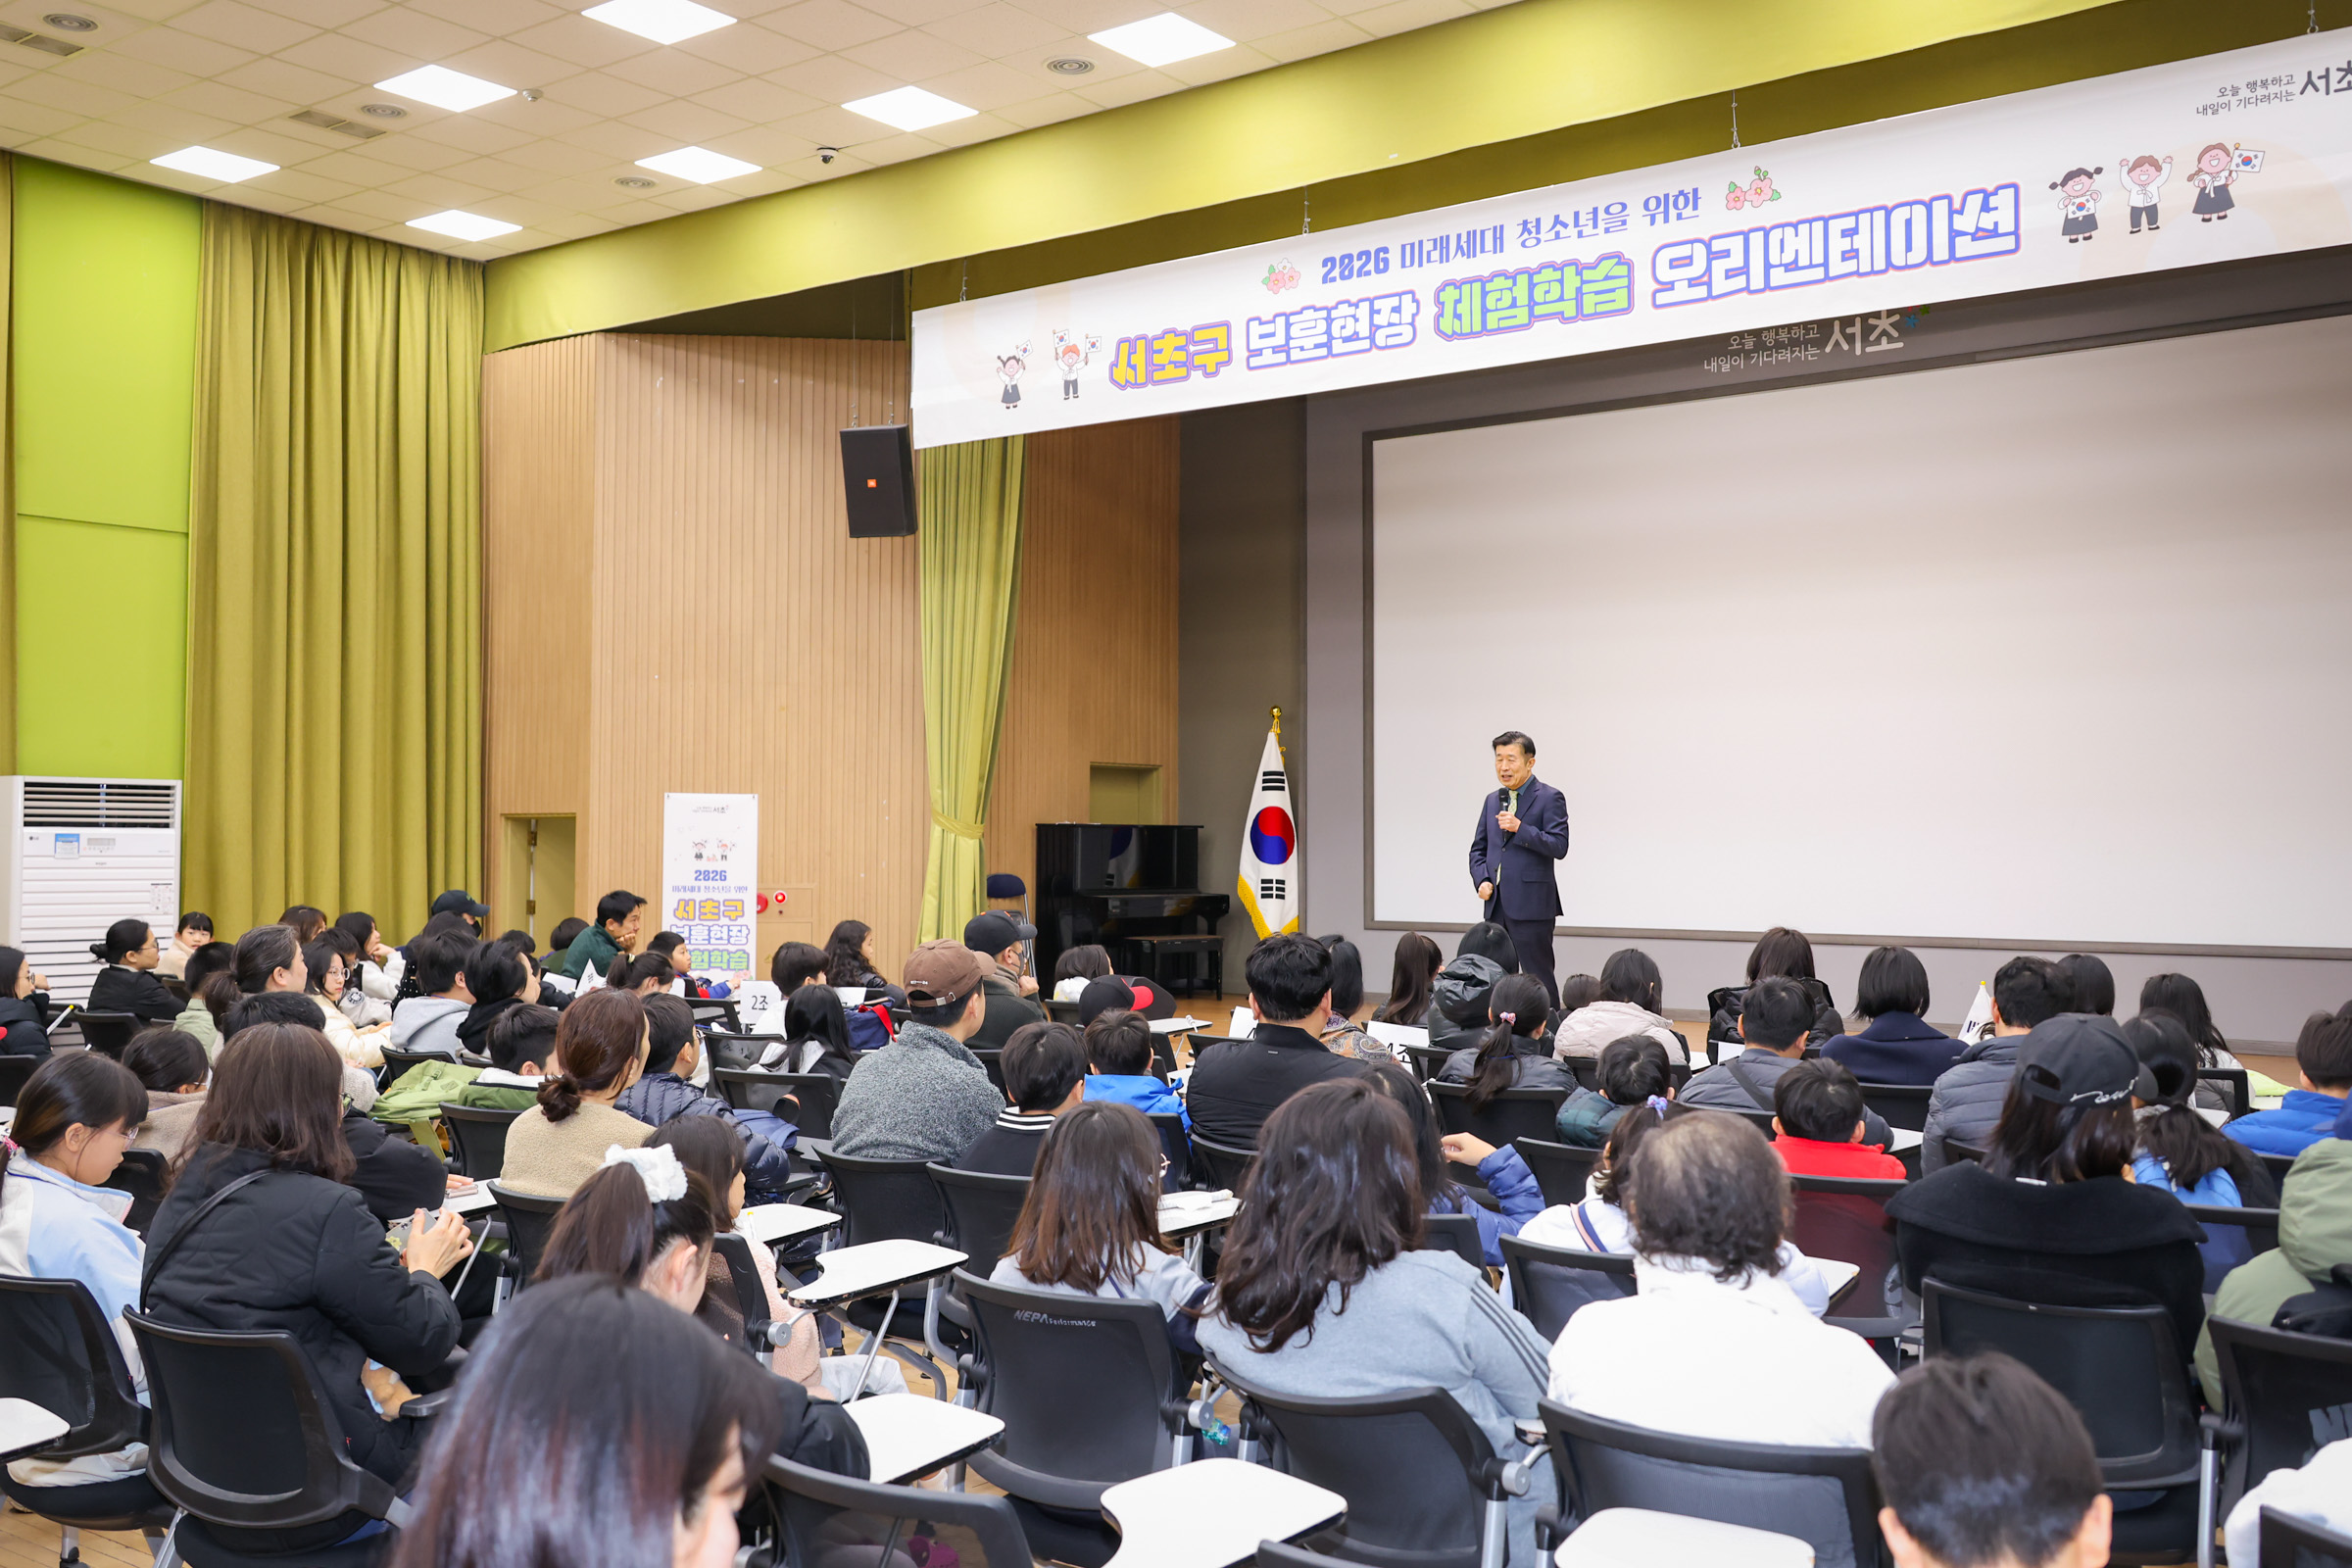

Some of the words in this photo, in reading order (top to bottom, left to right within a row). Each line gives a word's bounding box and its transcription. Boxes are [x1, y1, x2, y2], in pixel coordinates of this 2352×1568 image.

[2217, 84, 2240, 97] 오늘
[2246, 74, 2295, 93] 행복하고
[2196, 100, 2231, 116] 내일이
[2235, 89, 2296, 109] 기다려지는
[1322, 246, 1390, 284] 2026
[1400, 224, 1504, 269] 미래세대
[1516, 202, 1630, 248] 청소년을
[1642, 187, 1702, 226] 위한
[1109, 320, 1233, 390] 서초구
[1246, 290, 1420, 370] 보훈현장
[1434, 251, 1635, 342] 체험학습
[1651, 181, 2022, 309] 오리엔테이션
[1728, 333, 1756, 350] 오늘
[1761, 323, 1820, 346] 행복하고
[1825, 310, 1904, 356] 서초
[1703, 353, 1744, 372] 내일이
[1750, 344, 1821, 367] 기다려지는
[694, 869, 727, 881] 2026
[673, 899, 745, 921] 서초구
[689, 949, 750, 970] 험학습
[752, 995, 768, 1010] 2조
[1014, 1310, 1048, 1324] NEPA
